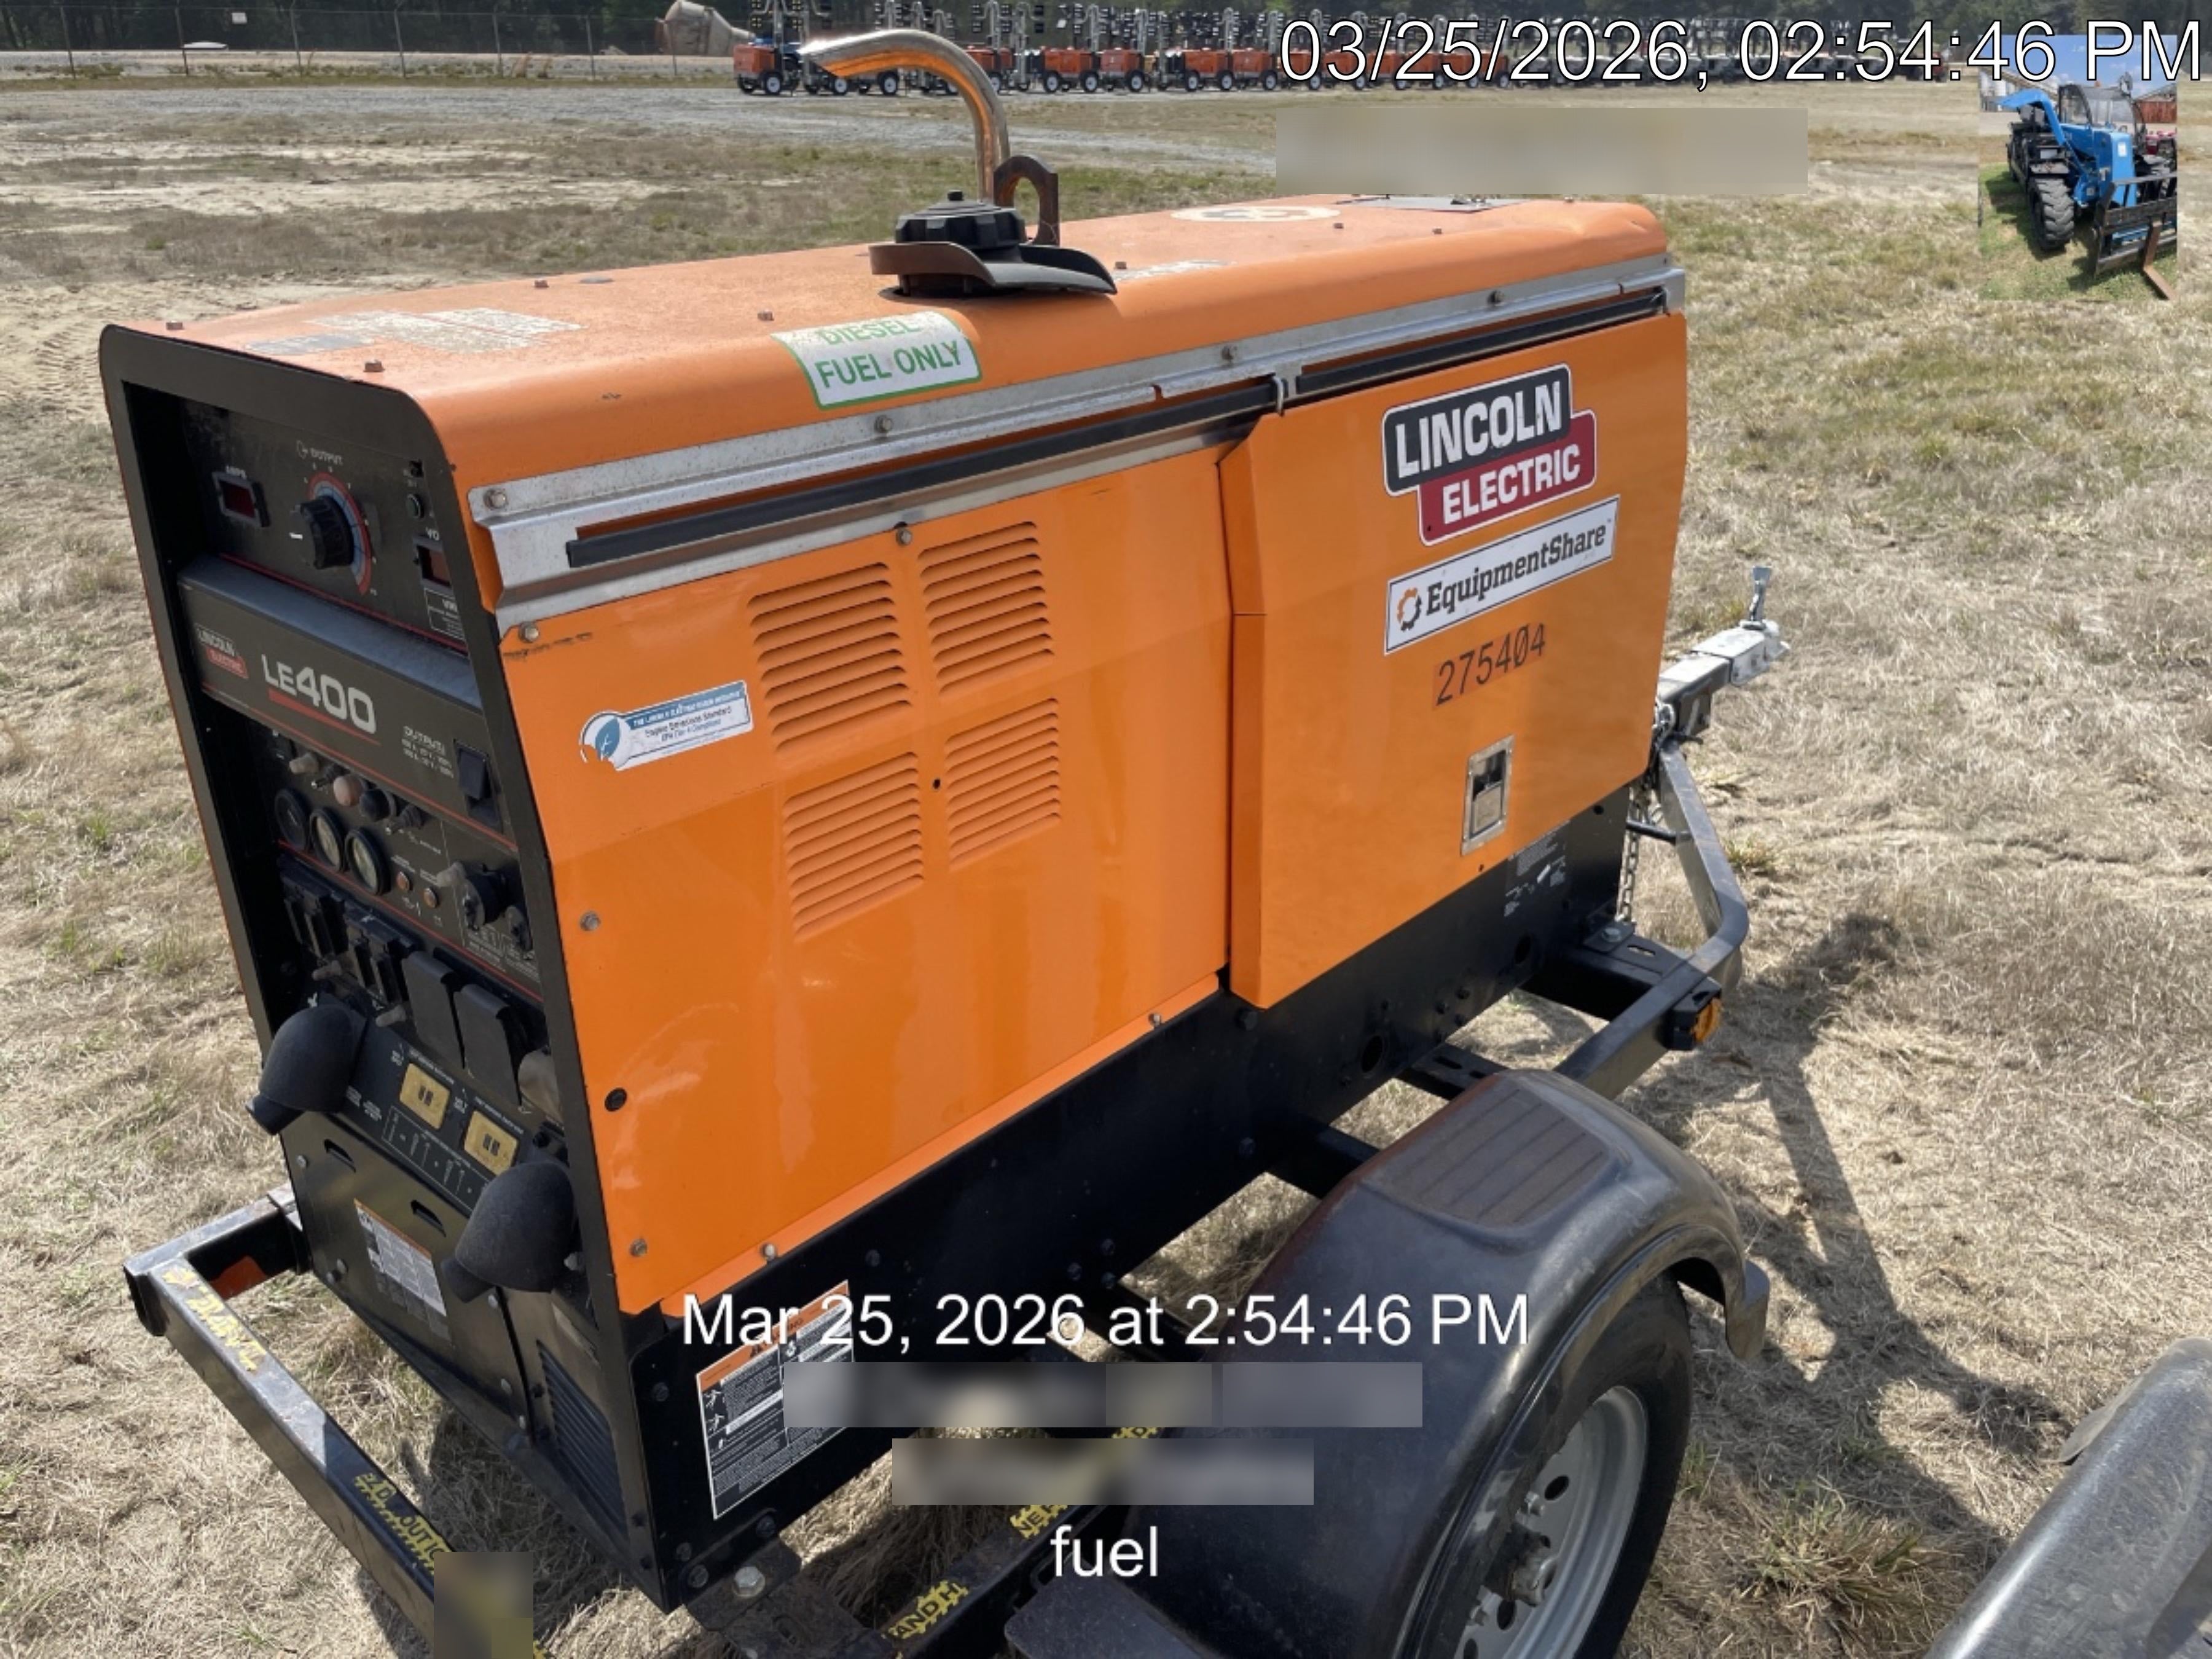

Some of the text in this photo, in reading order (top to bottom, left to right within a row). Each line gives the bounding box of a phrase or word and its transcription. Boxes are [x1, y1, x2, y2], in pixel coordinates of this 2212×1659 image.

[814, 340, 962, 388] FUEL ONLY
[817, 318, 924, 345] DIESEL
[1395, 380, 1563, 479] LINCOLN
[1442, 443, 1580, 525] ELECTRIC
[1426, 524, 1607, 615] EquipmentShare
[261, 653, 377, 735] LE400
[1435, 622, 1546, 706] 275404
